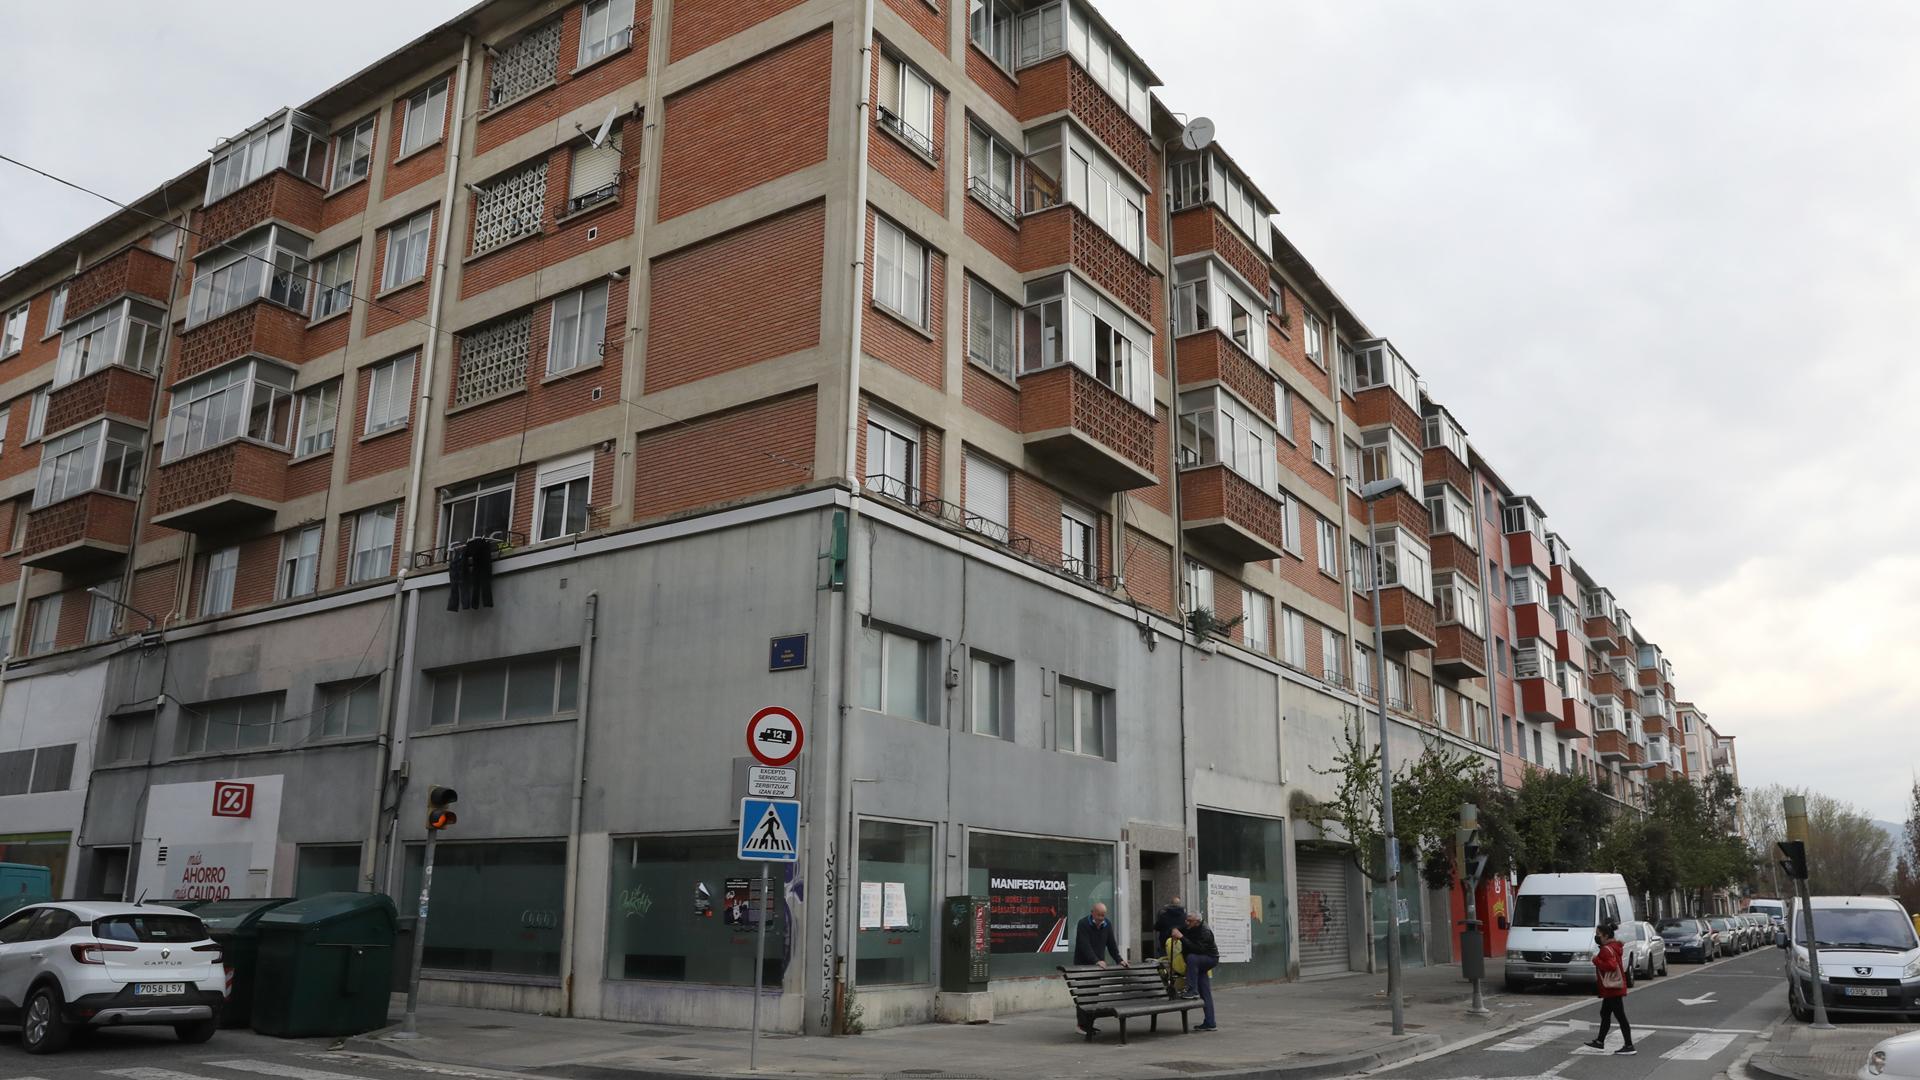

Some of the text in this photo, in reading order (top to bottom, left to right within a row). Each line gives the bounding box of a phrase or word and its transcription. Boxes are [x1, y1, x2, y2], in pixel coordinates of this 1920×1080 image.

[772, 730, 786, 739] 12t
[182, 867, 226, 883] AHORRO
[991, 878, 1066, 891] MANIFESTAZIOA
[188, 886, 230, 900] CALIDAD
[140, 984, 164, 993] 7058
